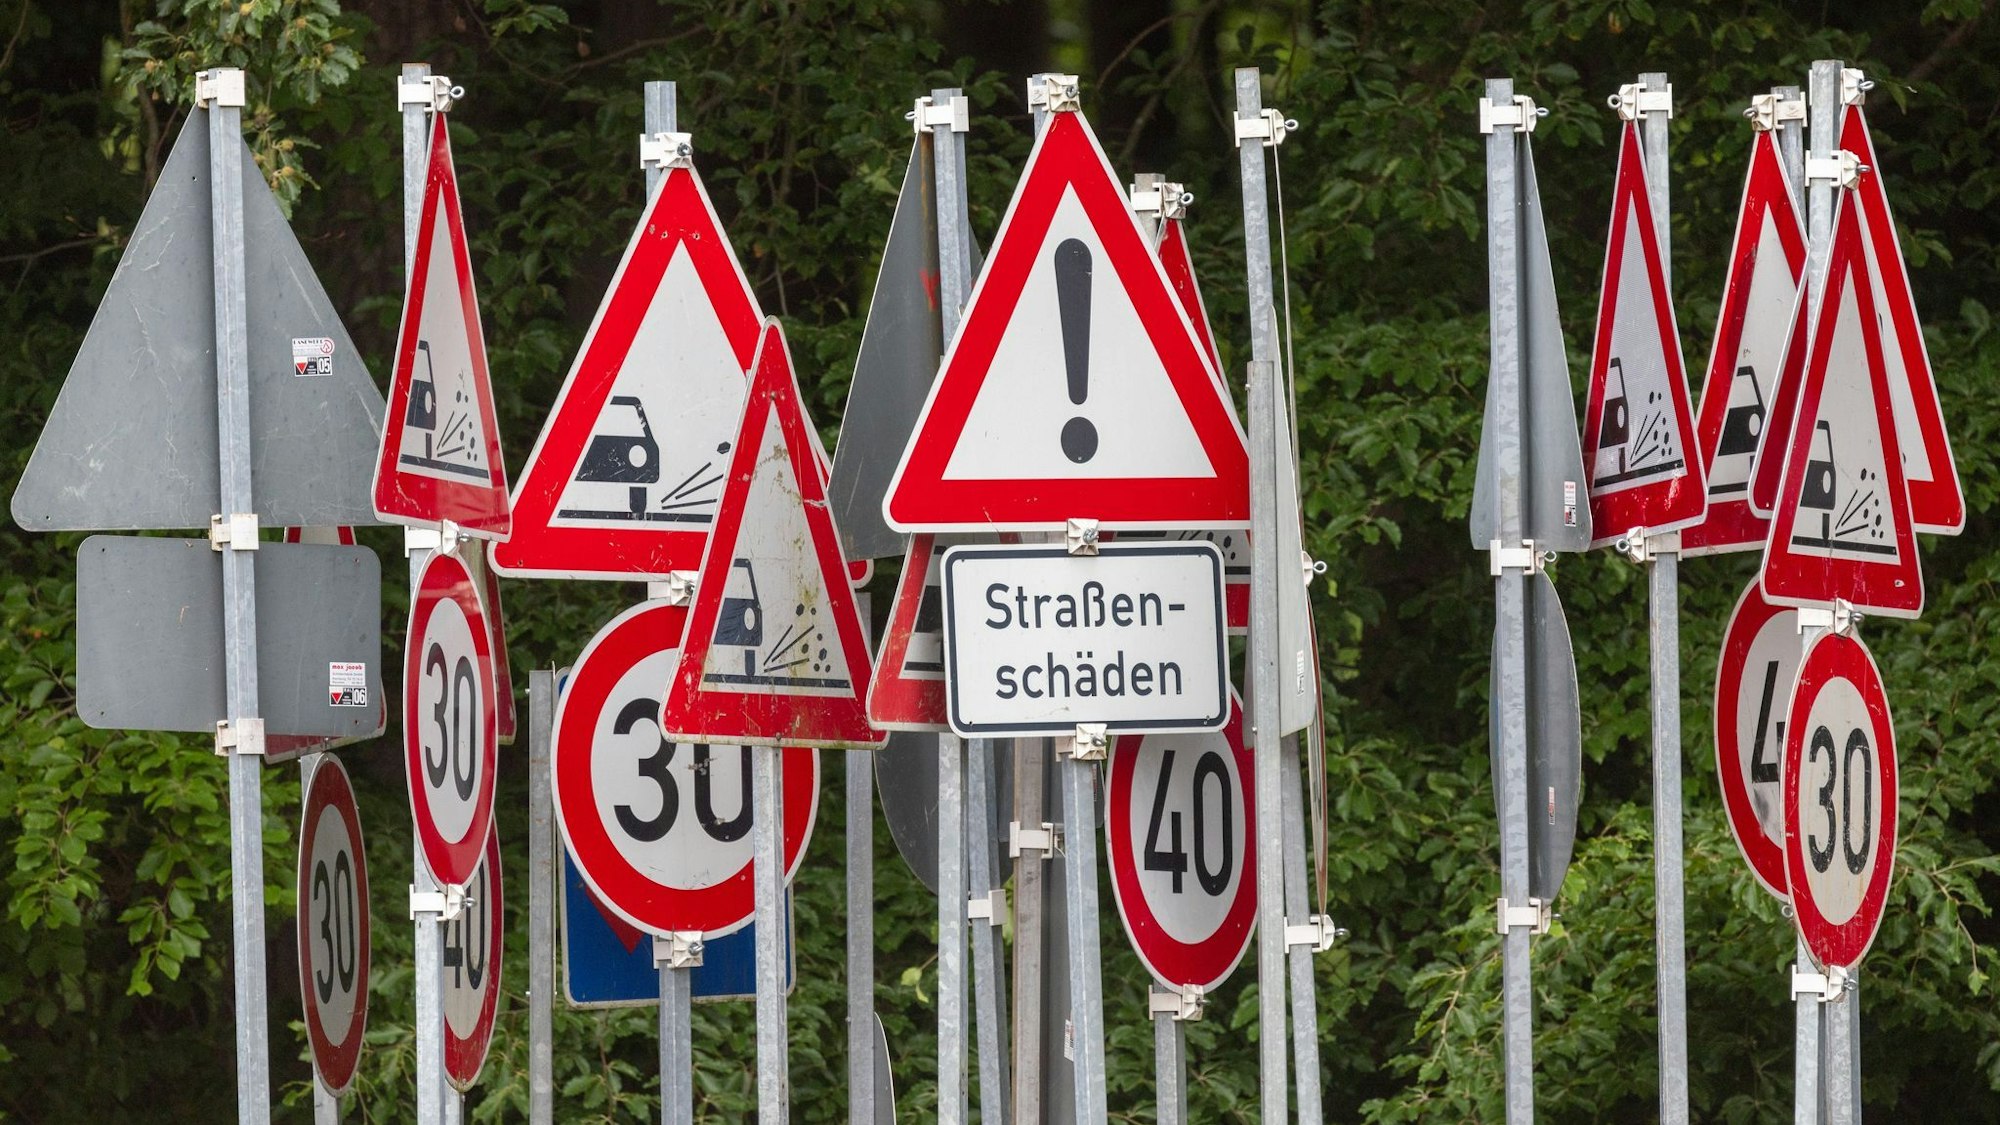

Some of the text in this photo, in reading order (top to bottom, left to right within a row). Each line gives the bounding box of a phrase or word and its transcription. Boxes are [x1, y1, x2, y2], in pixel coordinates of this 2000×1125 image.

[319, 358, 330, 373] 05
[985, 581, 1185, 630] Straßen-
[996, 650, 1182, 699] schäden
[354, 689, 365, 704] 06
[425, 642, 476, 802] 30
[1752, 660, 1785, 795] 4
[613, 697, 754, 843] 30
[1144, 750, 1233, 896] 40
[1808, 725, 1871, 875] 30
[314, 850, 355, 1004] 30
